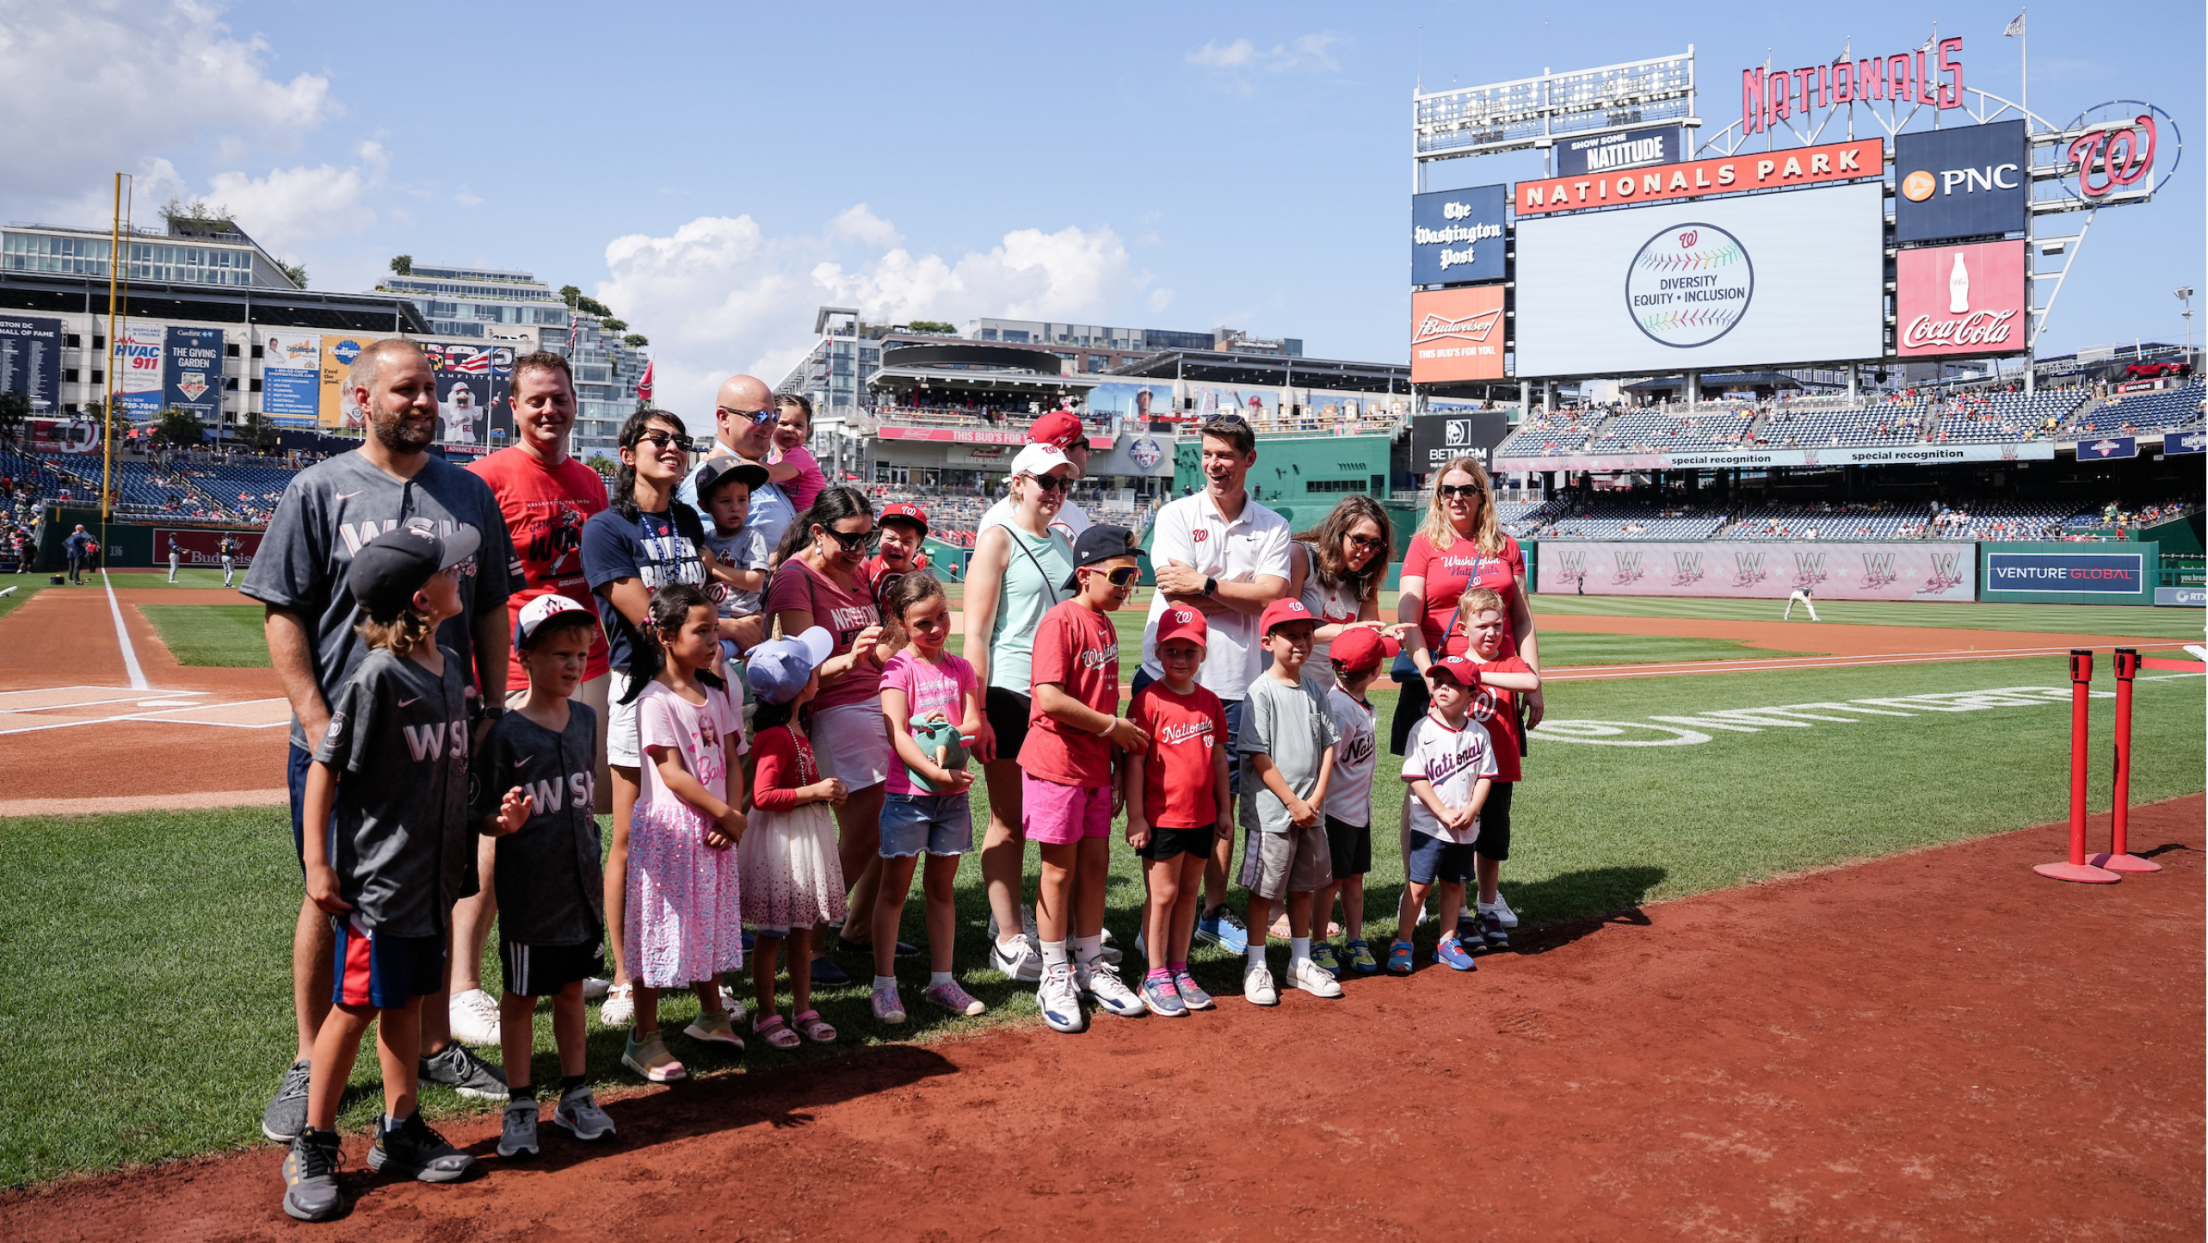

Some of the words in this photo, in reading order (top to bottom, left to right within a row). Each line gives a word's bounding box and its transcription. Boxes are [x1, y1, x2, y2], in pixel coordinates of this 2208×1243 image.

[1742, 36, 1963, 135] NATIONALS
[1571, 138, 1598, 151] SHOW
[1600, 133, 1627, 146] SOME
[1587, 135, 1664, 171] NATITUDE
[1527, 164, 1736, 207] NATIONALS
[1758, 149, 1861, 180] PARK
[1941, 163, 2019, 196] PNC
[1443, 201, 1471, 220] The
[1415, 221, 1501, 246] Washington
[1440, 246, 1475, 270] Post
[1660, 274, 1718, 290] DIVERSITY
[1634, 293, 1674, 307] EQUITY
[1684, 287, 1746, 303] INCLUSION
[1419, 311, 1494, 336] Budweiser
[1903, 308, 2018, 349] Coca-Cola
[115, 345, 160, 358] HVAC
[173, 347, 188, 357] THE
[189, 348, 216, 358] GIVING
[327, 345, 362, 358] Pedigr
[1418, 348, 1443, 359] THIS
[1444, 347, 1461, 358] BUD'S
[1462, 346, 1477, 357] FOR
[1478, 345, 1496, 356] YOU.
[132, 357, 158, 370] 911
[178, 358, 210, 368] GARDEN
[953, 430, 972, 441] THIS
[975, 431, 1002, 443] BUD'S
[1003, 433, 1022, 443] FOR
[448, 445, 472, 453] ADVANCE
[1430, 447, 1487, 460] BETMGM
[1852, 450, 1892, 462] special
[1895, 449, 1963, 461] recognition
[1671, 455, 1708, 466] special
[1710, 454, 1771, 465] recognition
[109, 545, 123, 556] 336
[1997, 567, 2067, 579] VENTURE
[2070, 568, 2133, 580] GLOBAL
[1162, 715, 1214, 745] Nationals
